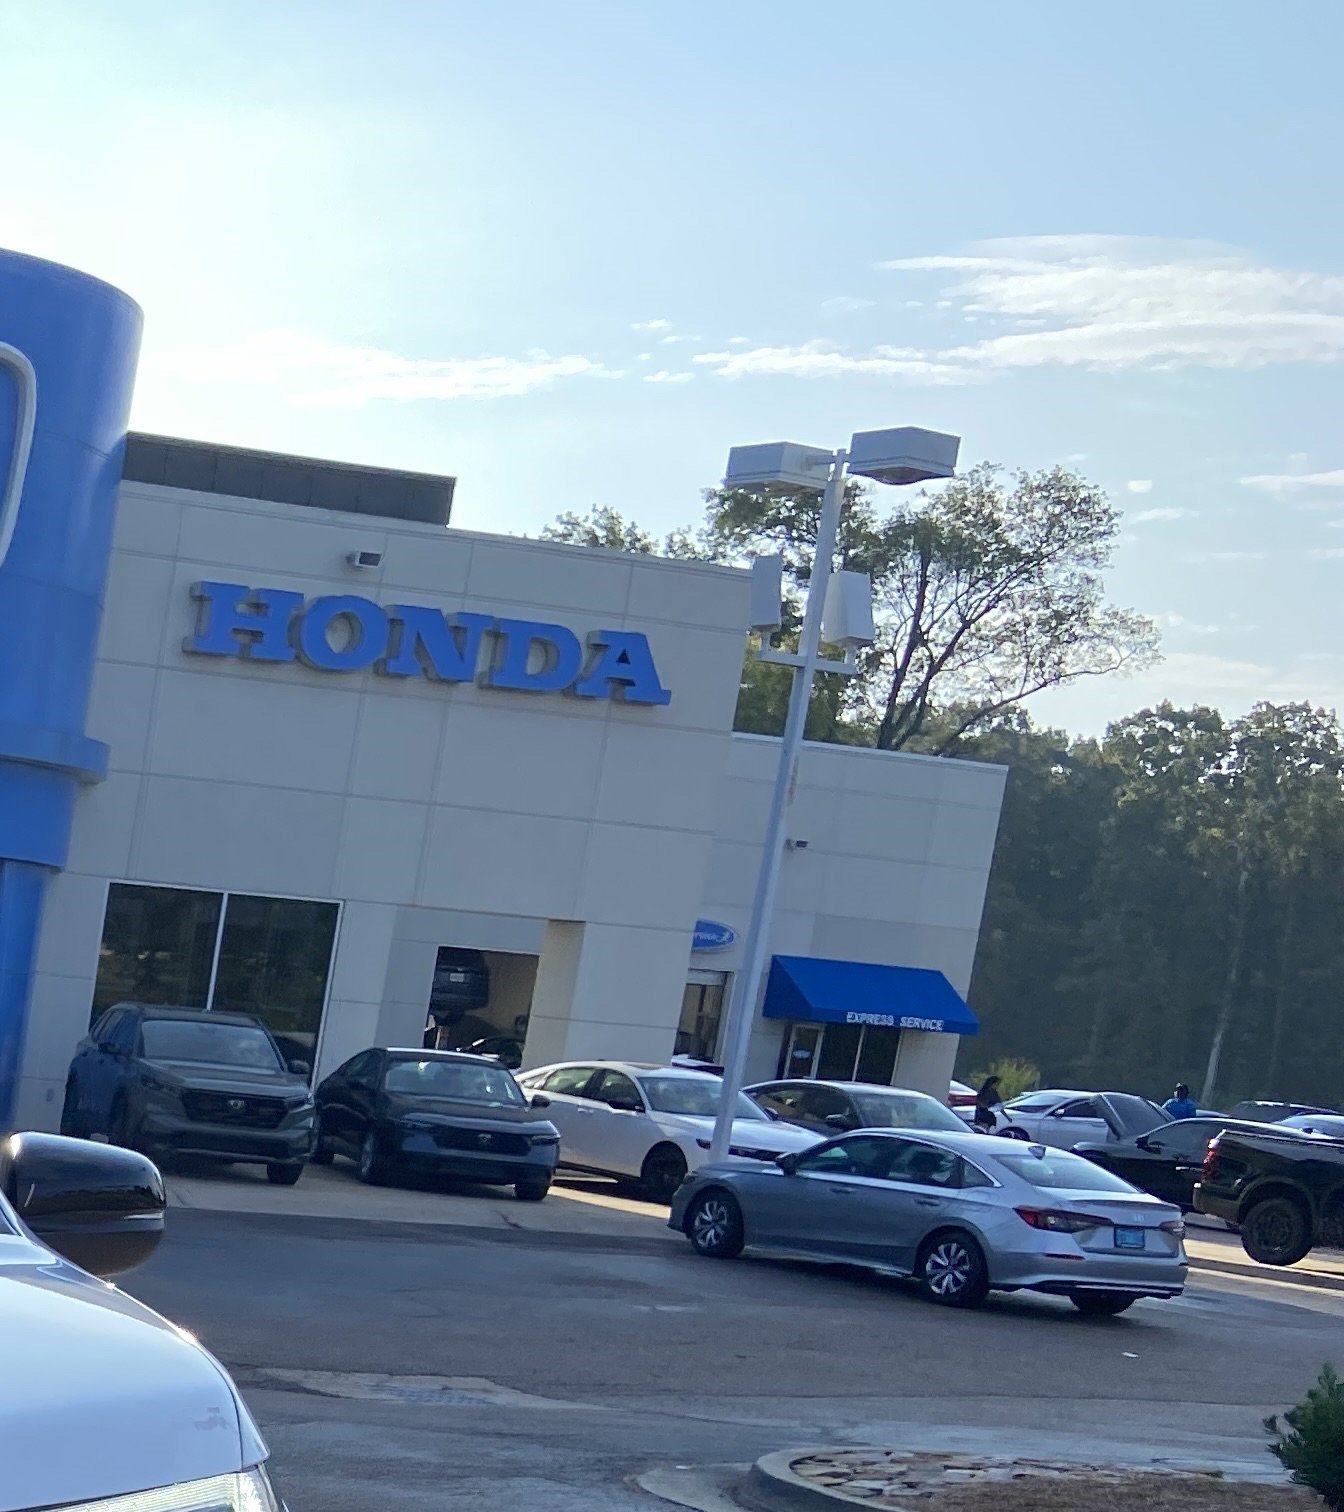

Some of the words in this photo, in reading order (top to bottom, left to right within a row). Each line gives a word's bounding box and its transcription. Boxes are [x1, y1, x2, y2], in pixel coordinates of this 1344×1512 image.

[183, 580, 672, 706] HONDA
[846, 1011, 894, 1026] EXPRESS
[900, 1016, 945, 1031] SERVICE
